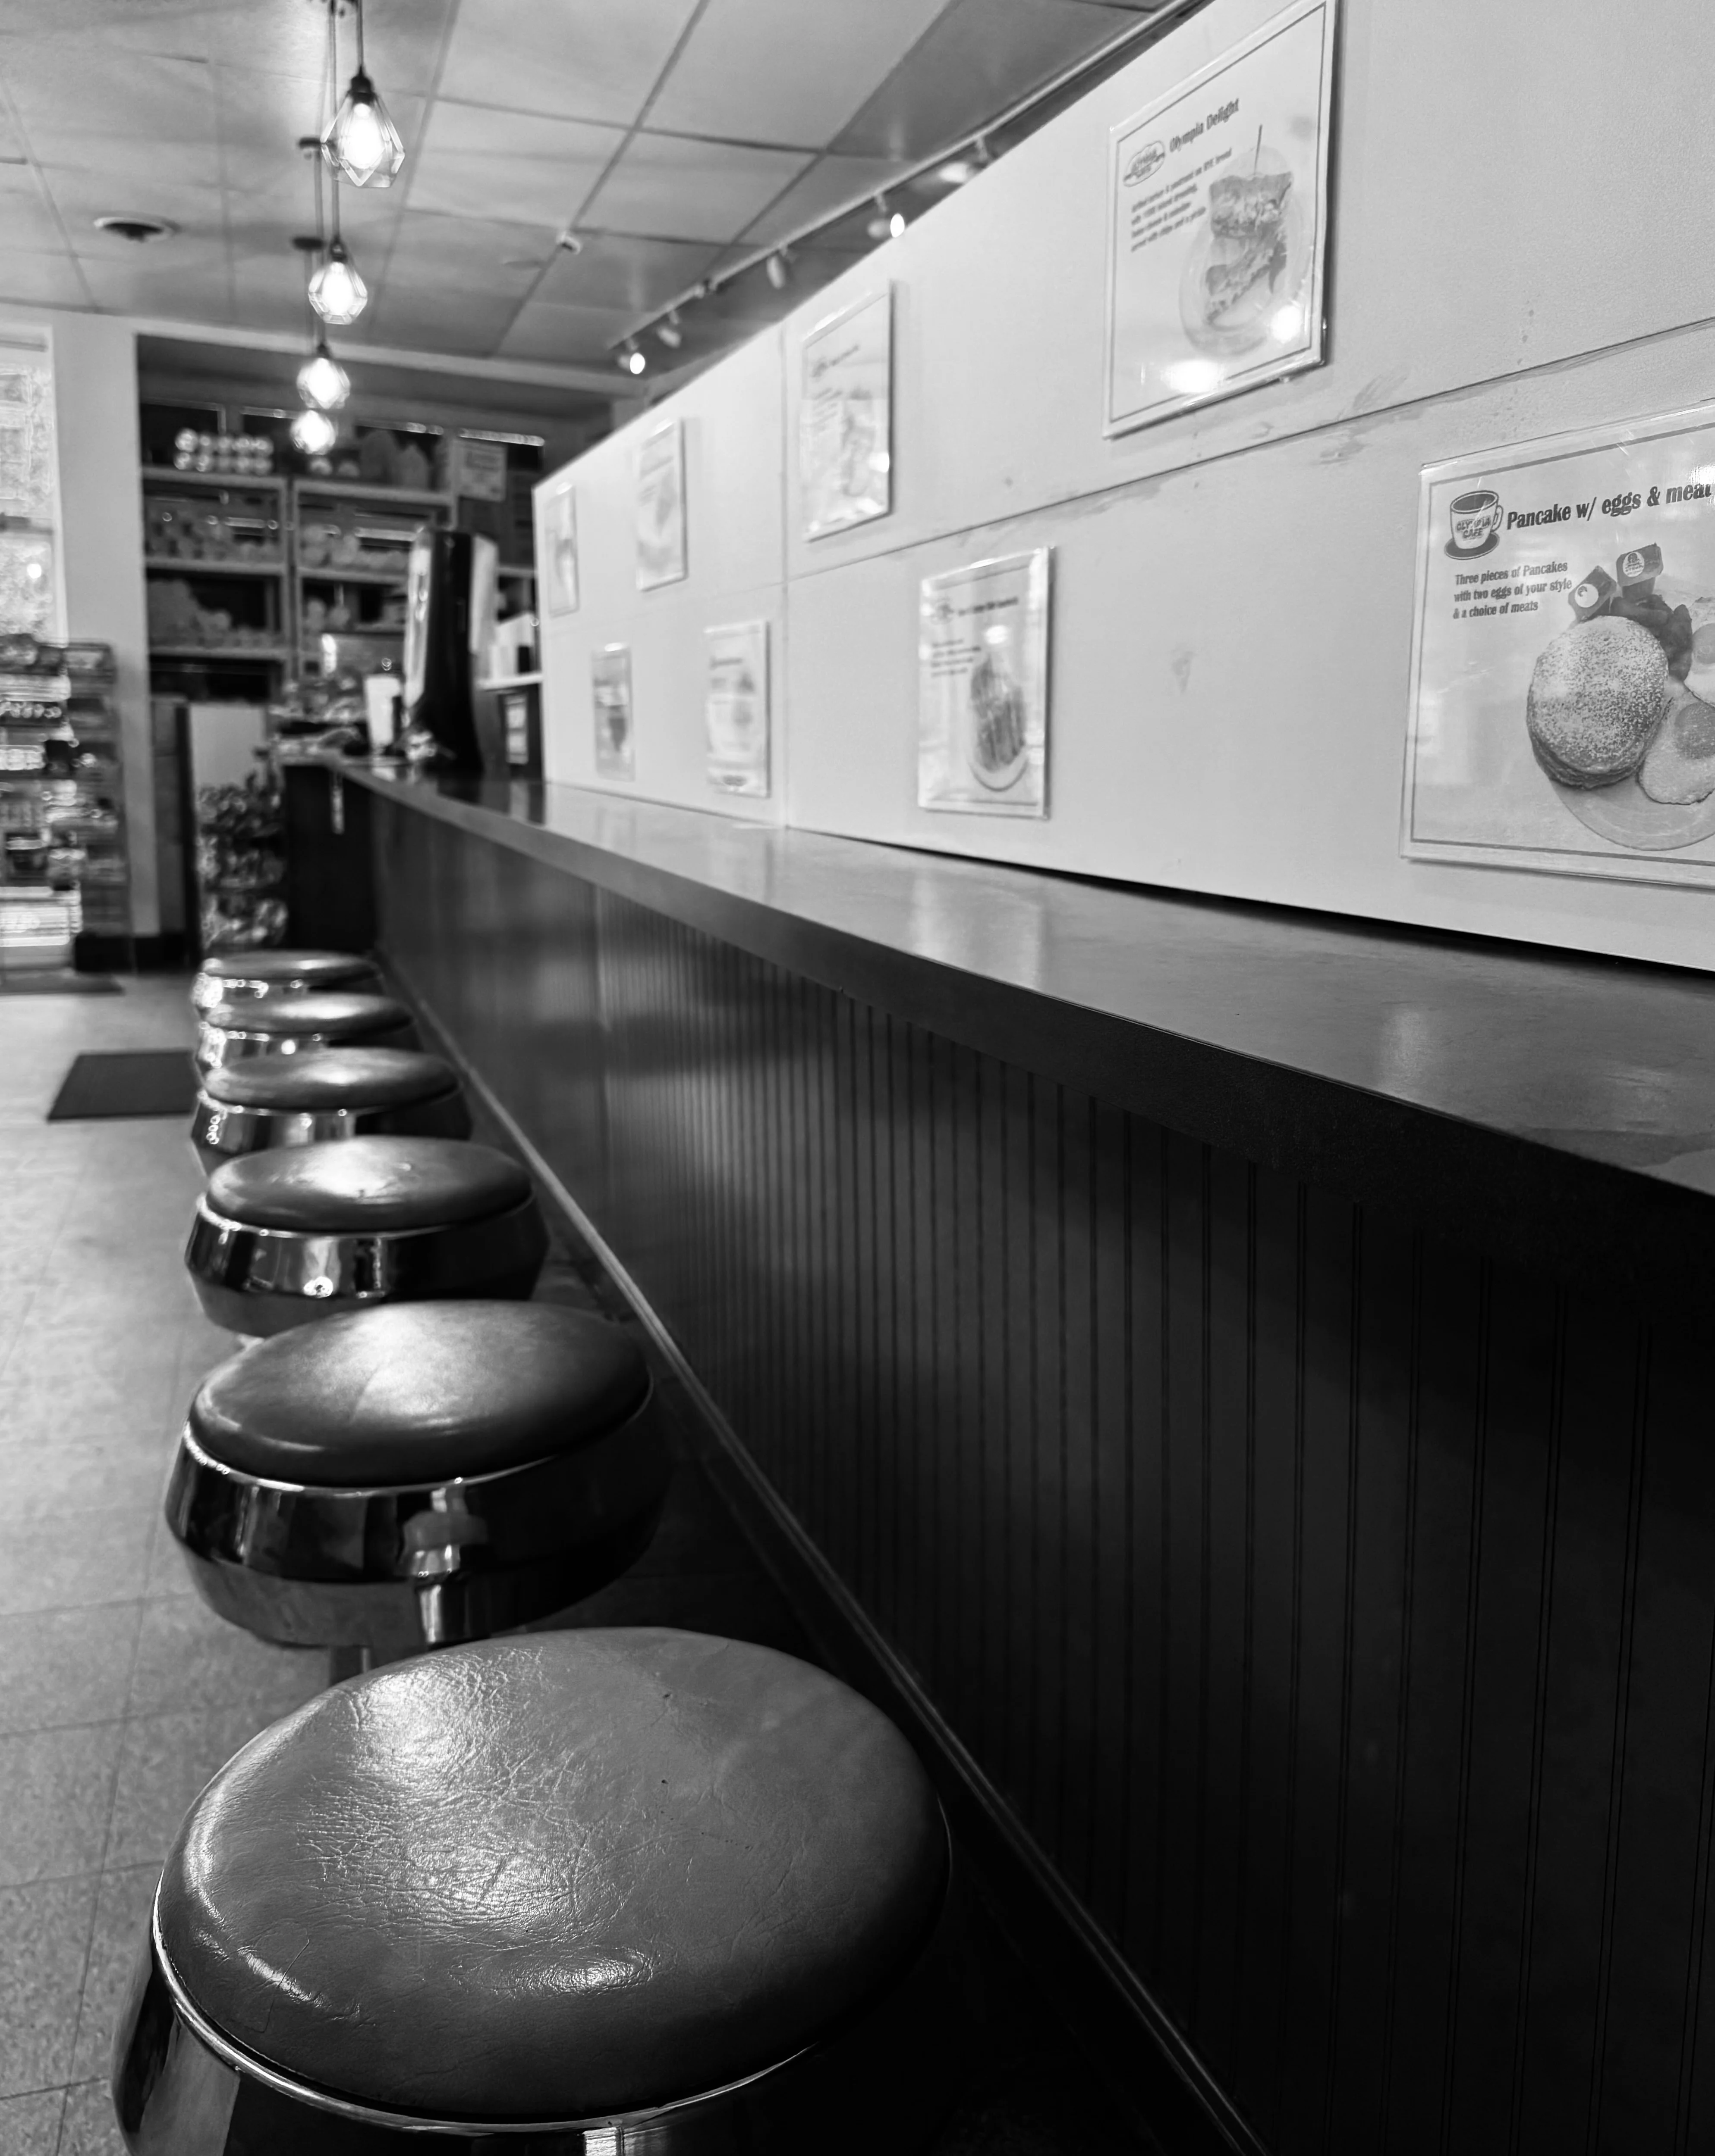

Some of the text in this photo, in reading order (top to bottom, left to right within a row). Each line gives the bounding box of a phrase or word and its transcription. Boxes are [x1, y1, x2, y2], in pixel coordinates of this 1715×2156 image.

[1507, 503, 1571, 530] Pancake
[1576, 497, 1597, 521] w/
[1602, 492, 1641, 517] eggs
[1647, 486, 1661, 507] &
[1455, 561, 1568, 585] Three pieces of Pancakes
[1454, 577, 1573, 602] with two eggs of your style
[1469, 605, 1497, 617] choice
[1499, 602, 1510, 614] of
[1510, 600, 1539, 613] meats
